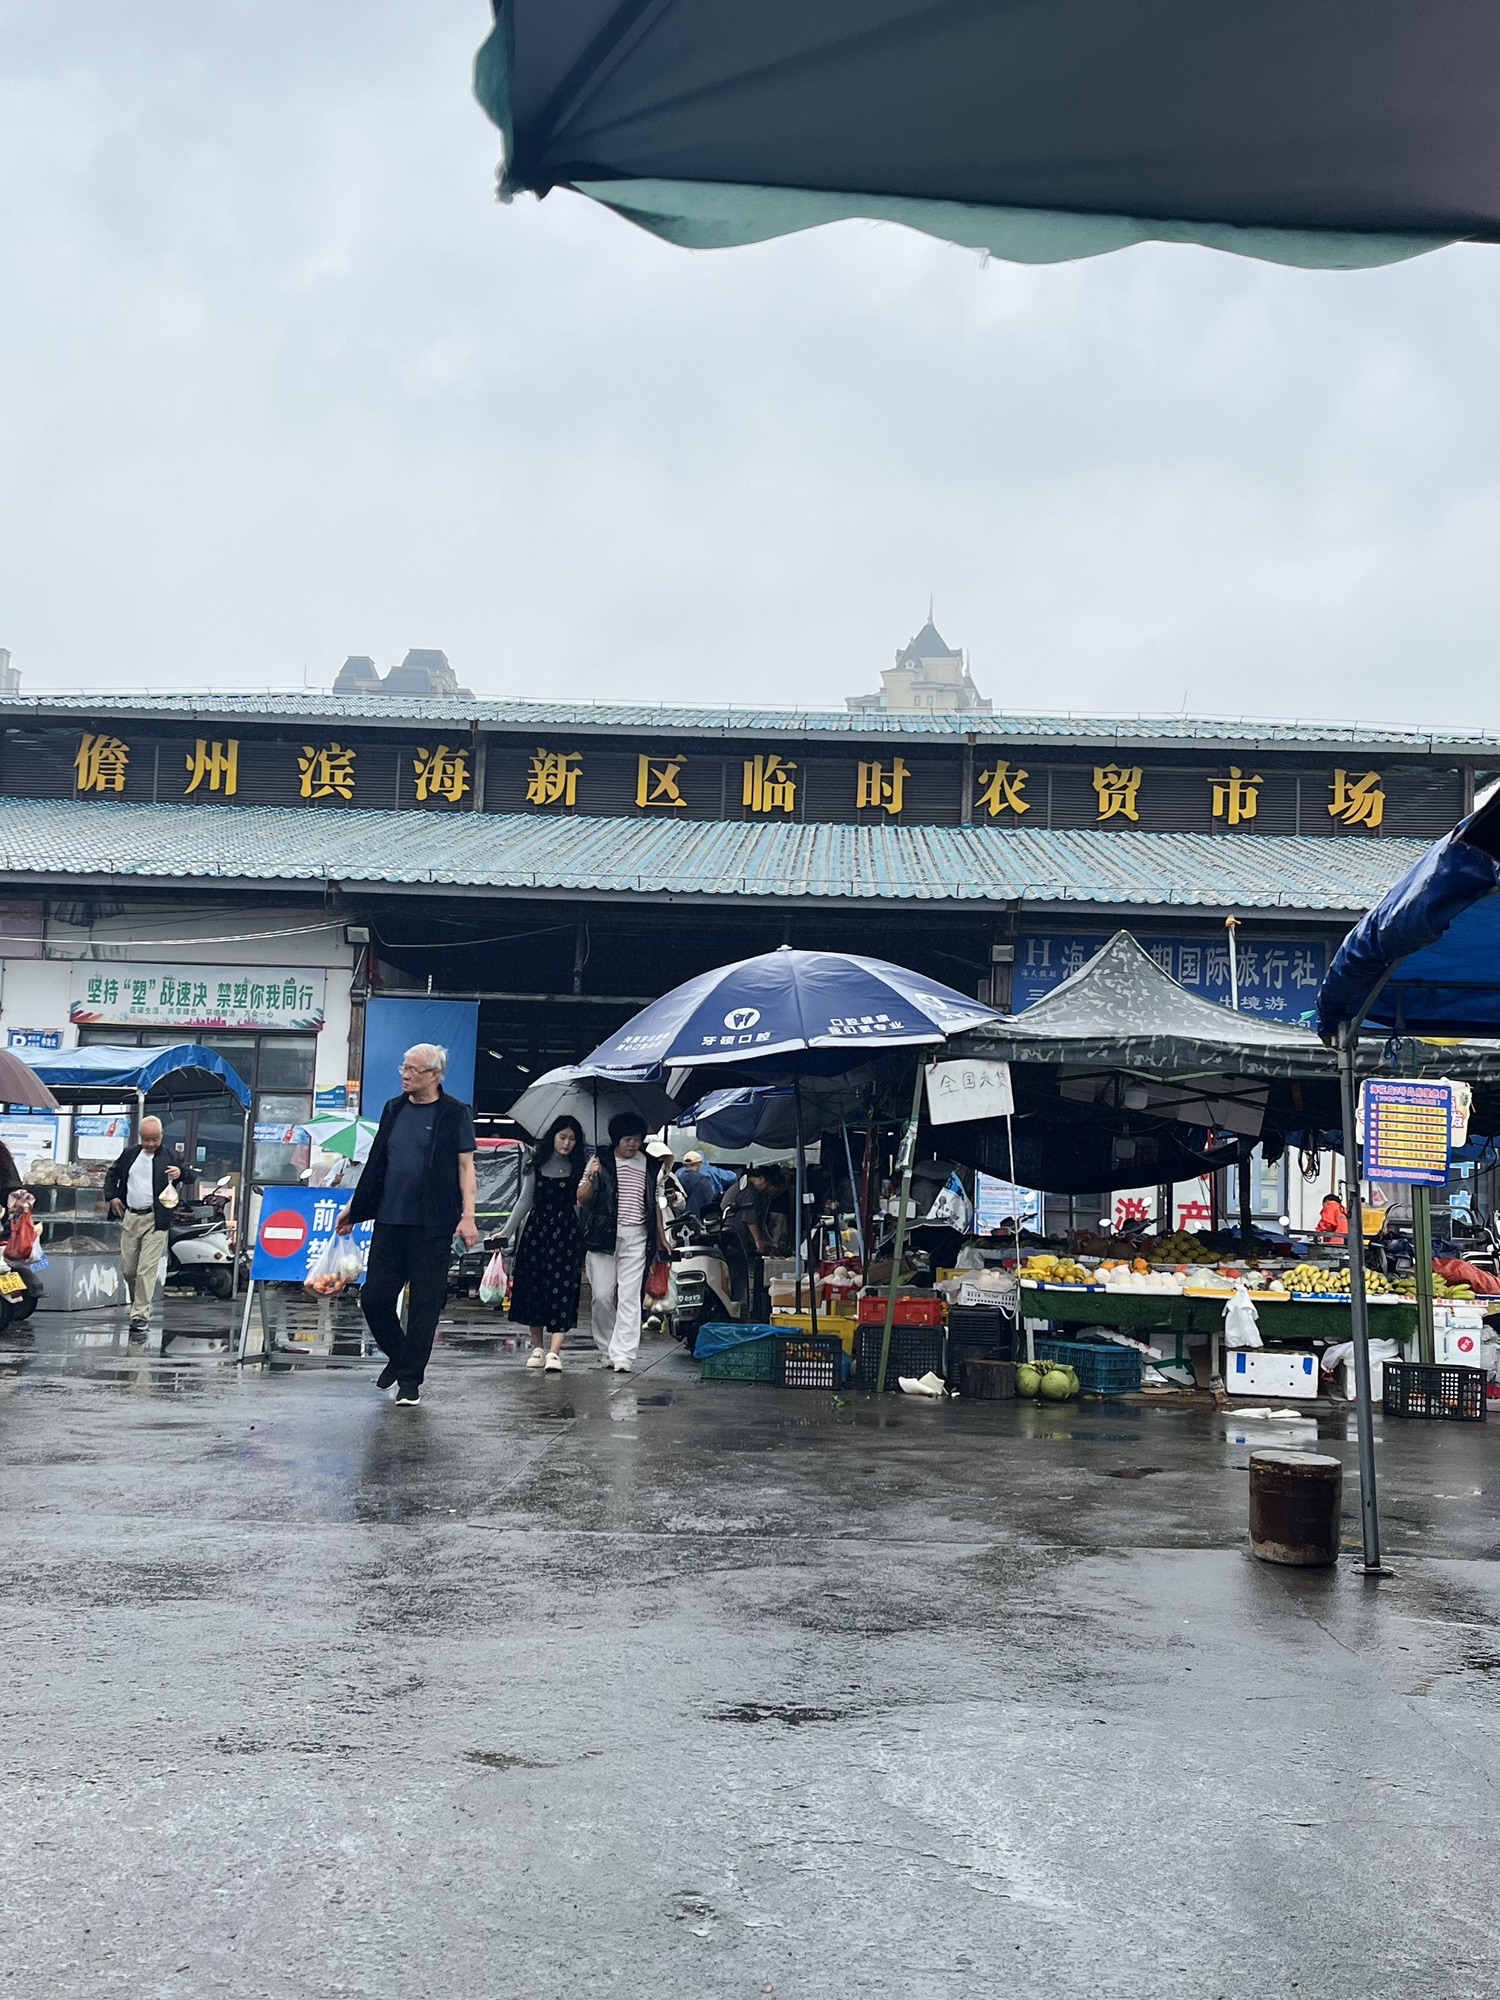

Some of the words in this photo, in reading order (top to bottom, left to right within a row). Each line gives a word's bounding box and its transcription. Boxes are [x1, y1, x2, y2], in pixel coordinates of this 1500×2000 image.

[74, 734, 1385, 828] 儋州滨海新区临时农贸市场
[1026, 939, 1051, 966] H
[1061, 941, 1318, 989] 海期国际旅行社
[216, 981, 314, 1010] 禁塑你我同行
[827, 1021, 904, 1035] 我们更专业
[829, 1014, 891, 1027] 口腔健康
[701, 1031, 771, 1046] 牙硕口腔
